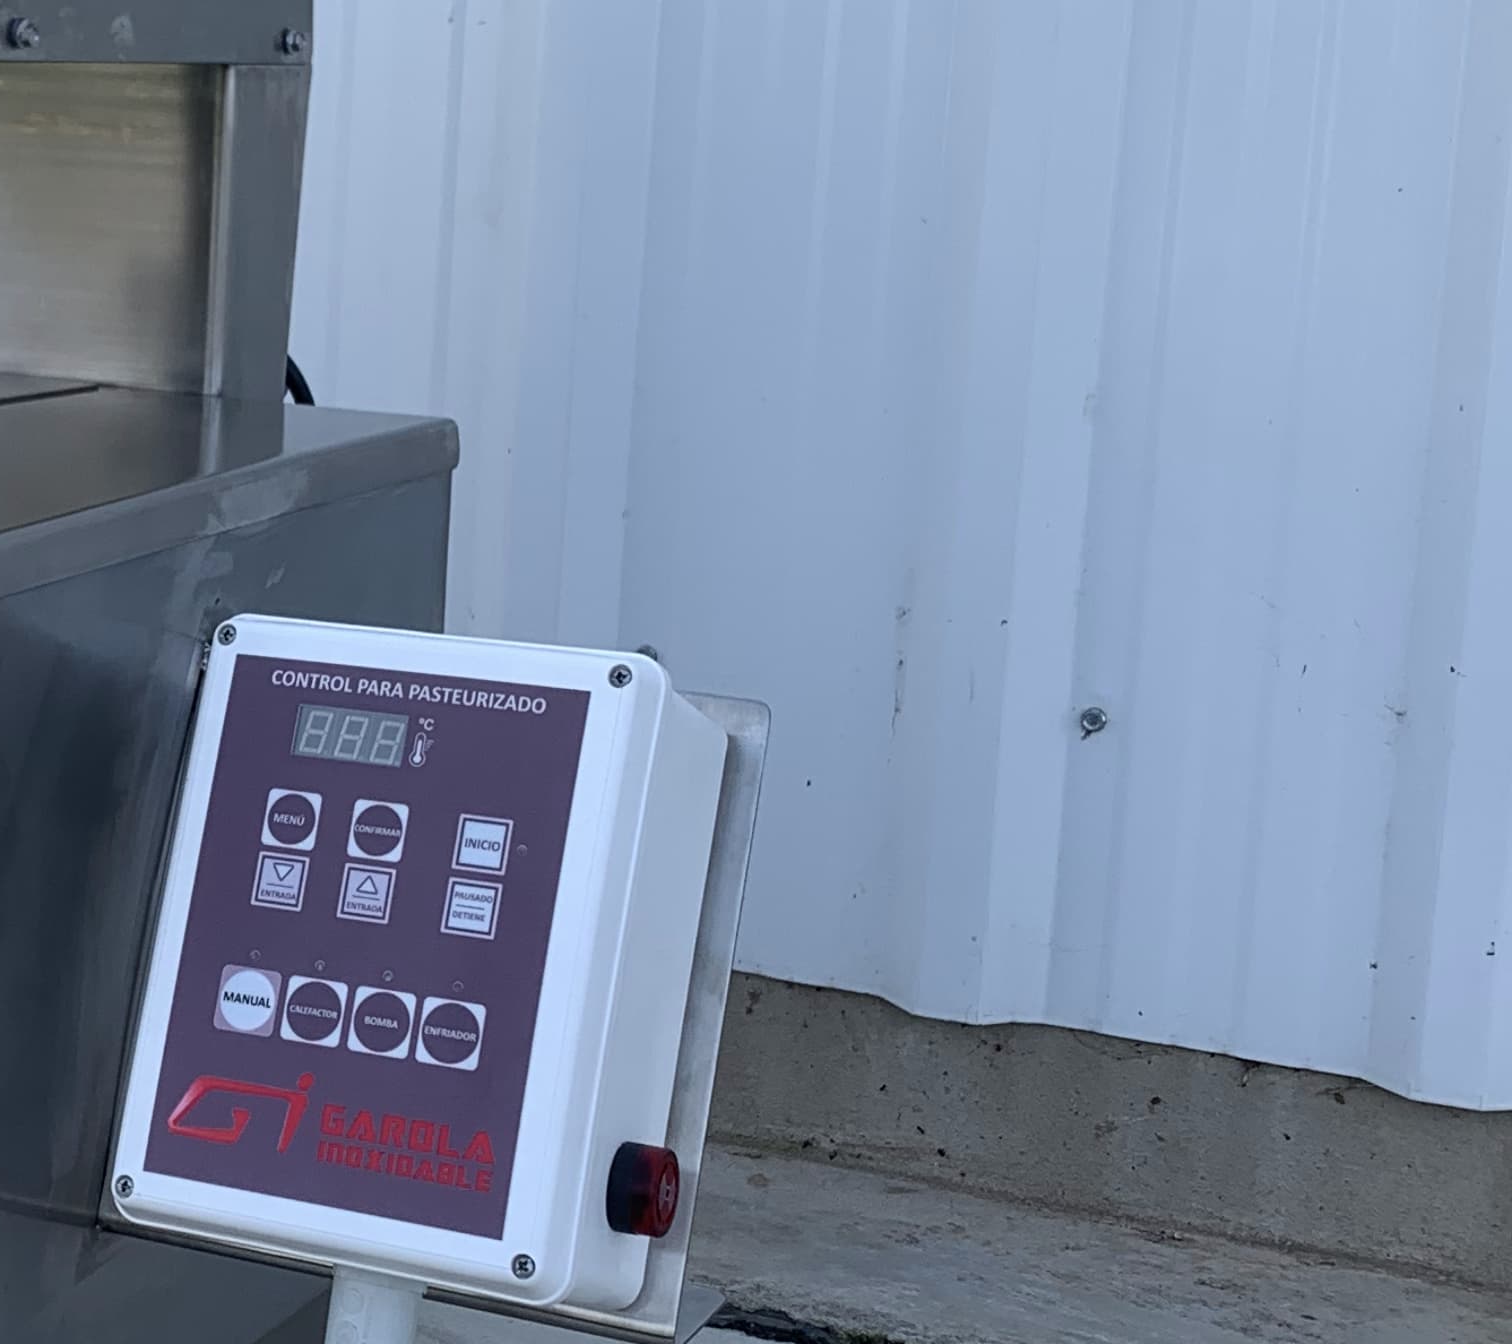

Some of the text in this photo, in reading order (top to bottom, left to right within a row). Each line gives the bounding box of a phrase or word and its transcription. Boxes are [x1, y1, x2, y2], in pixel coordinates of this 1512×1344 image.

[271, 669, 547, 715] CONTROL PARA PASTEURIZADO
[273, 812, 305, 827] MENÚ
[354, 824, 402, 837] CONFIRMAR
[464, 838, 501, 852] INICIO
[260, 889, 296, 901] ENTRADA
[454, 891, 494, 904] PAUSADO
[346, 901, 383, 913] ENTRADA
[452, 910, 485, 922] DETIENE
[223, 991, 272, 1009] MANUAL
[289, 1004, 338, 1020] CALEFACTOR
[364, 1015, 398, 1030] BOMBA
[424, 1025, 477, 1043] ENFRIADOR
[320, 1103, 495, 1166] GAROLA
[317, 1140, 494, 1193] INOXIDABLE
